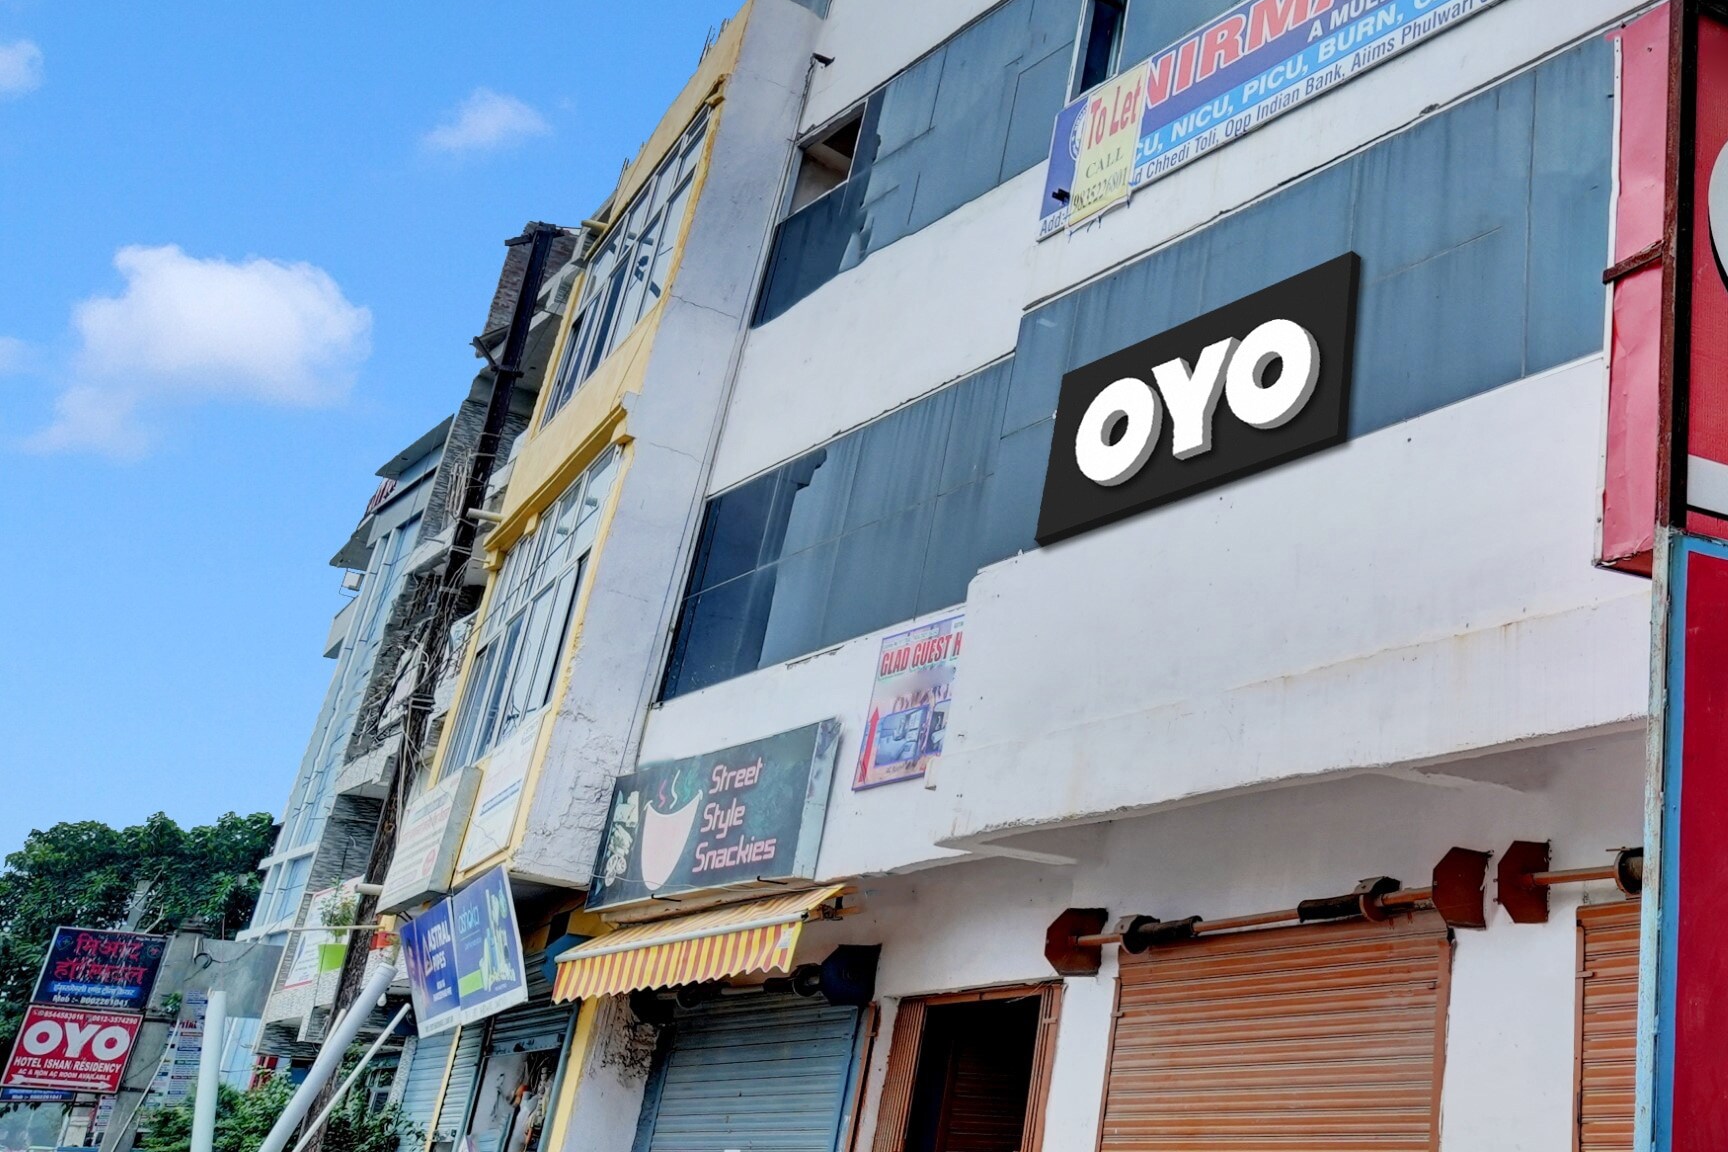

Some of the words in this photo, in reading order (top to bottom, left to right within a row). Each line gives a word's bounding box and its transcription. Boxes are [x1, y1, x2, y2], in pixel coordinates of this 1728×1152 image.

[1307, 19, 1324, 43] A
[1170, 95, 1234, 143] NICU,
[1242, 54, 1309, 104] PICU,
[1318, 3, 1403, 64] BURN,
[1087, 97, 1107, 149] To
[1109, 76, 1141, 137] Let
[1146, 143, 1190, 178] Chhedi
[1225, 116, 1251, 138] Opp
[1256, 87, 1300, 122] Indian
[1305, 65, 1345, 97] Bank,
[1351, 37, 1395, 72] Aiims
[1085, 147, 1124, 179] CALL
[1075, 318, 1320, 487] OYO
[880, 647, 911, 678] GLAD
[912, 634, 953, 669] GUEST
[709, 757, 764, 795] Street
[700, 798, 745, 839] Style
[692, 834, 777, 873] Snackies
[428, 920, 450, 948] ASTRAL
[23, 1020, 131, 1061] OYO
[14, 1056, 42, 1068] HOTEL
[43, 1059, 72, 1069] ISHAN
[73, 1060, 122, 1074] RESIDENCY
[78, 1073, 112, 1081] AVAILABLE
